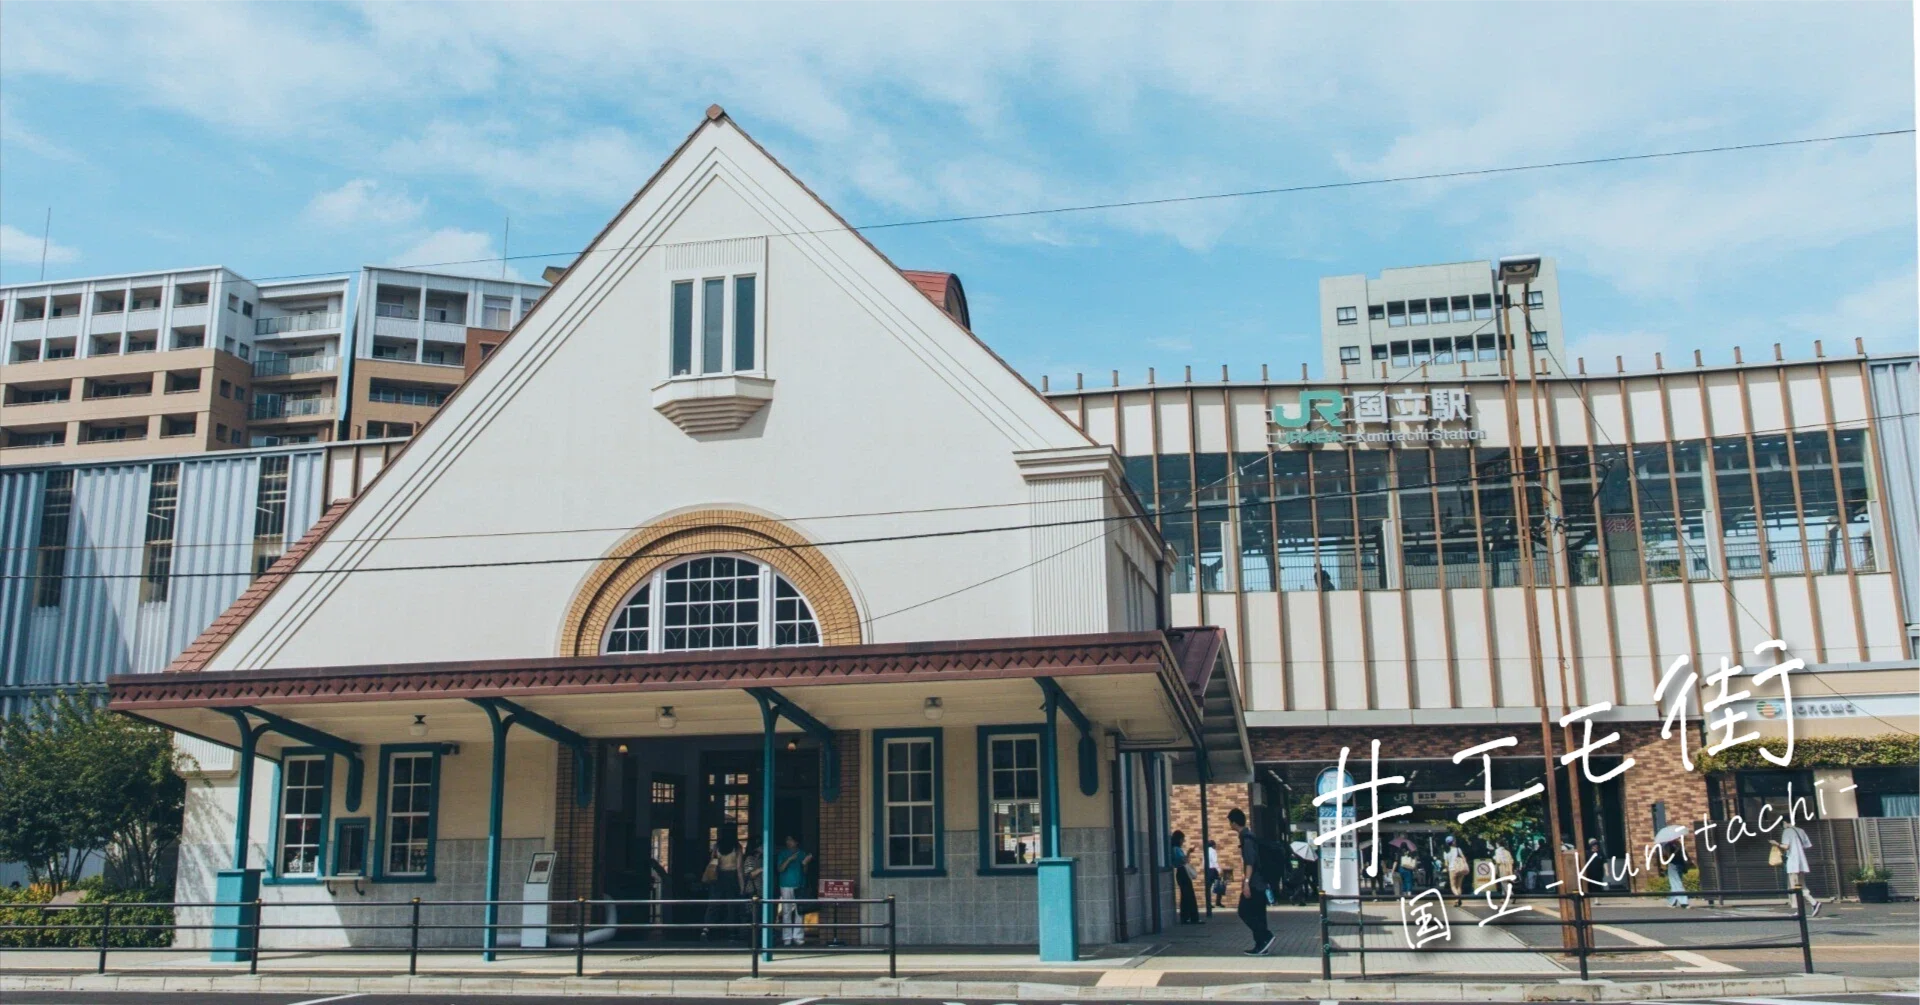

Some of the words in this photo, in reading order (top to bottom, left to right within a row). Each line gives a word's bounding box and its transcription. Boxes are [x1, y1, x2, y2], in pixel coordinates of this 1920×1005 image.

[1275, 390, 1344, 427] JR
[1352, 388, 1468, 424] 国立駅
[1356, 428, 1429, 442] Kunitachi
[1431, 427, 1487, 440] Station
